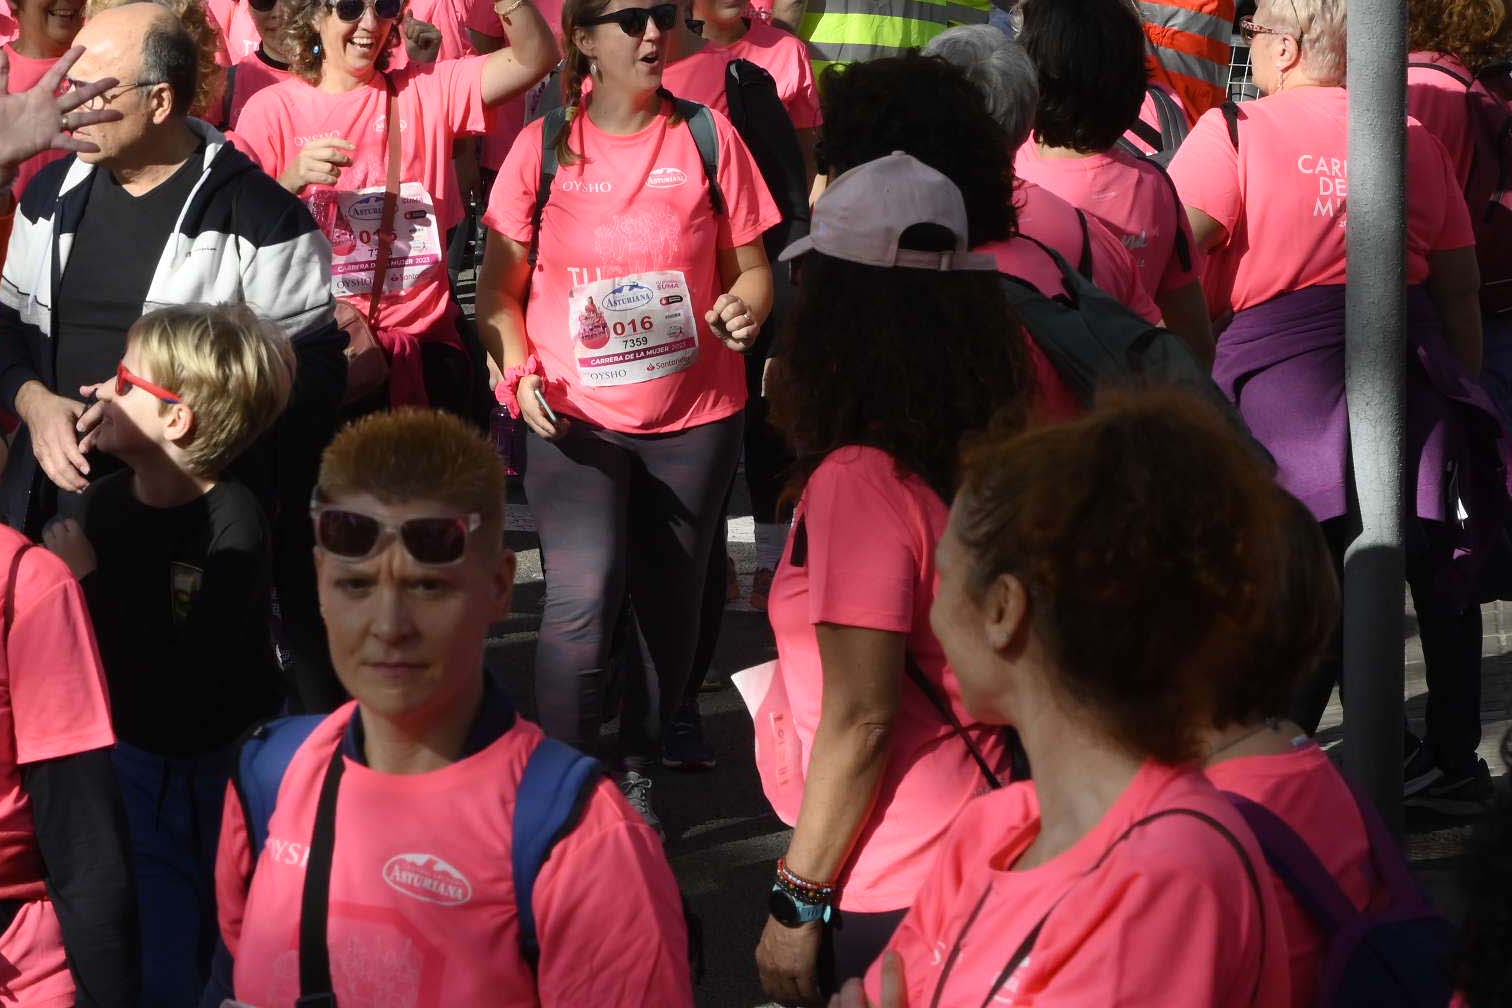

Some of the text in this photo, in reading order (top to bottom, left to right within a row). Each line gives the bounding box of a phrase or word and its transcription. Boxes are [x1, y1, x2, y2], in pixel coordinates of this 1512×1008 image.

[1297, 154, 1348, 177] CAR
[1319, 176, 1347, 197] DE
[606, 292, 651, 308] ASTURIANA
[612, 315, 654, 336] 016
[623, 336, 648, 349] 7359
[590, 355, 624, 365] CARRERA
[636, 351, 647, 359] LA
[647, 347, 669, 357] MUJER
[590, 368, 627, 380] OYSHO
[390, 864, 464, 900] ASTURIANA
